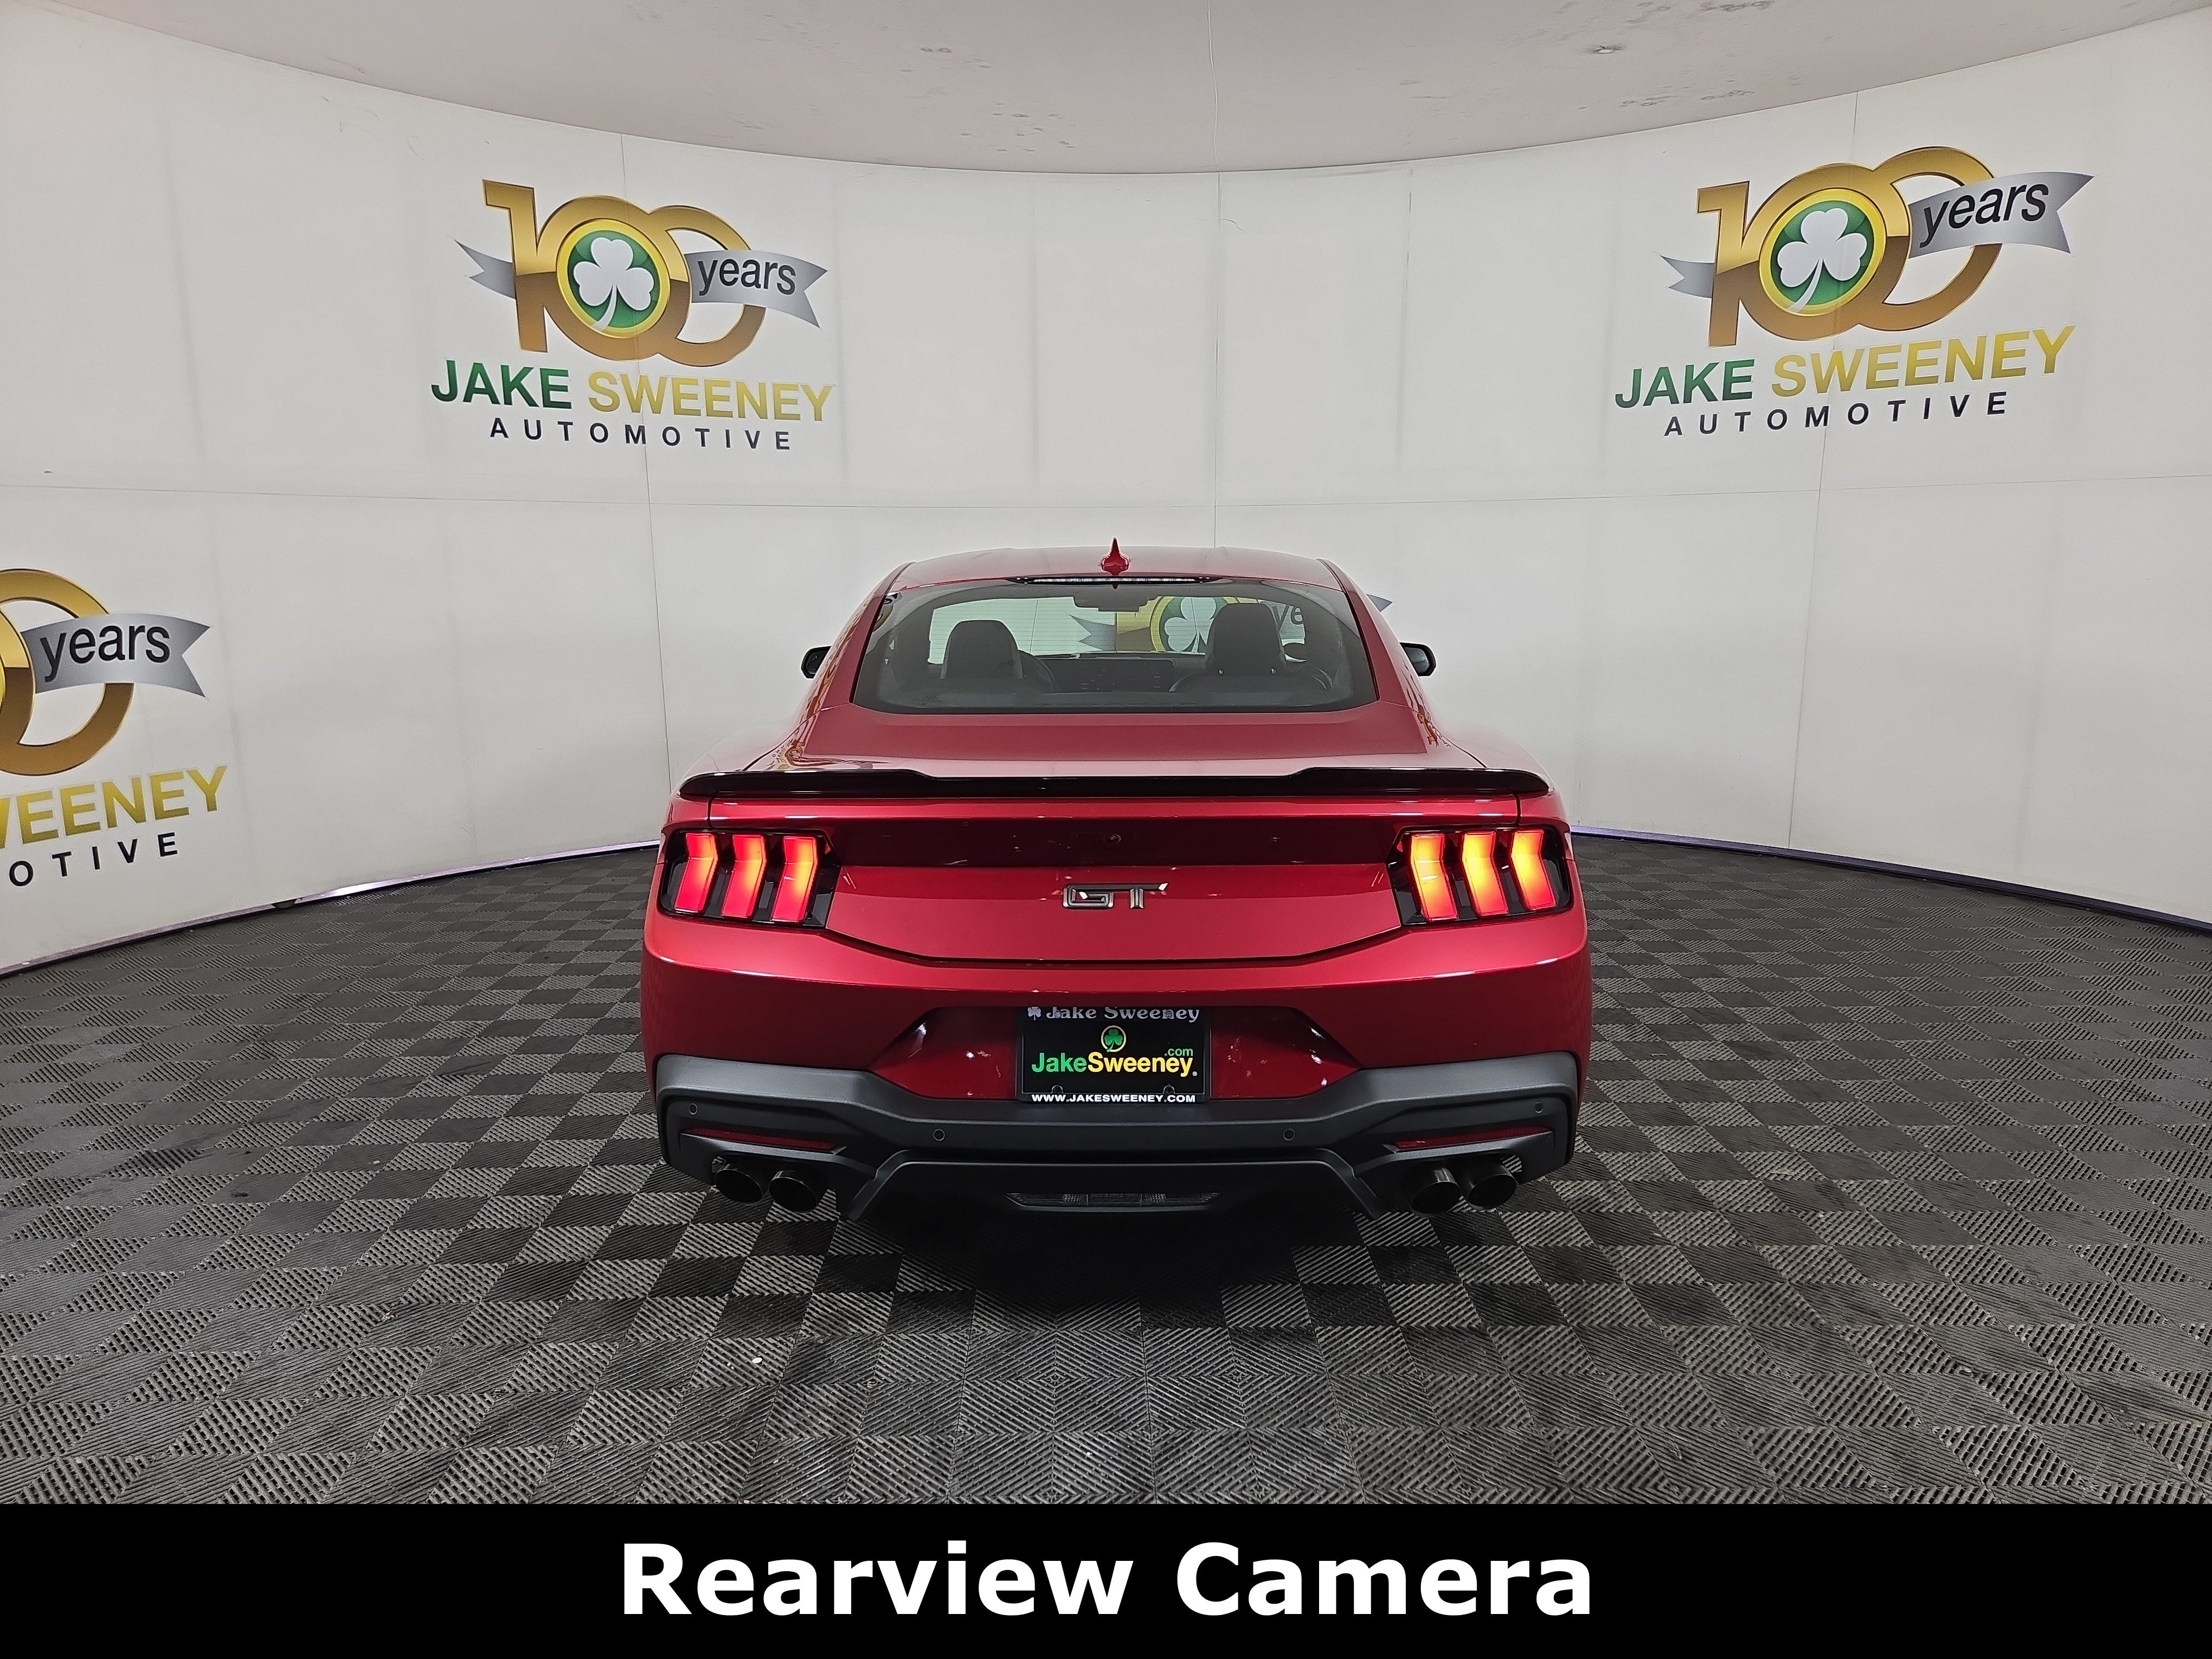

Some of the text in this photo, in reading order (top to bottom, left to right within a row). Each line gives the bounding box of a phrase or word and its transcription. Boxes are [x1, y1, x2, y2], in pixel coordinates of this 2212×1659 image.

[1920, 183, 2049, 248] years
[482, 179, 766, 366] 100
[697, 256, 796, 295] years
[1697, 146, 2003, 348] 100
[431, 359, 834, 421] JAKE SWEENEY
[1615, 325, 2076, 409] JAKE SWEENEY
[490, 417, 790, 451] AUTOMOTIVE
[1664, 391, 2008, 437] AUTOMOTIVE
[40, 625, 171, 682] years
[0, 765, 227, 850] EENEY
[1063, 883, 1168, 909] GT
[1046, 1006, 1200, 1023] Jake Sweeney
[1031, 1094, 1195, 1103] WWW.JAKESWEENEY.COM
